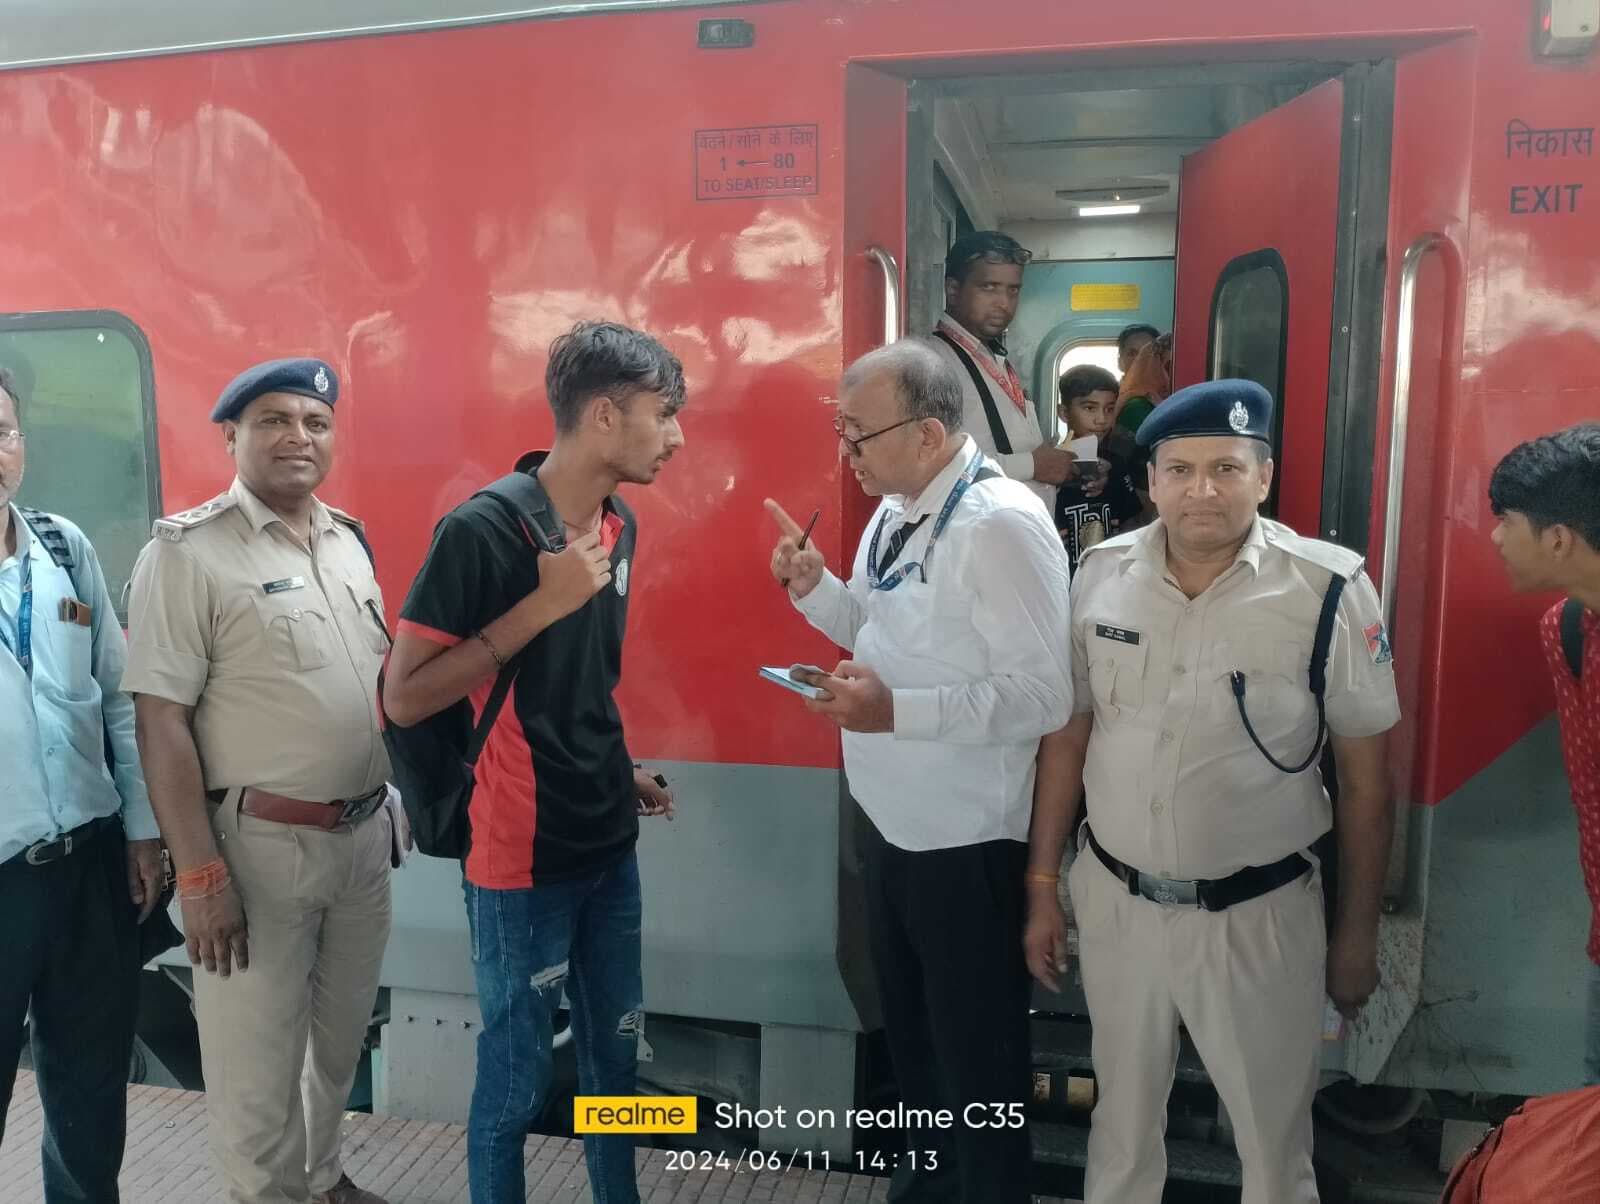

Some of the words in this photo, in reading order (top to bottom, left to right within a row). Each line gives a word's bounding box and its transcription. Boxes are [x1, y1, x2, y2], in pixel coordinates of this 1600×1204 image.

[1504, 117, 1595, 159] निकास
[719, 156, 727, 171] 1
[773, 152, 796, 169] 80
[704, 179, 721, 193] TO
[725, 175, 813, 192] SEAT/SLEEP
[1510, 183, 1584, 214] EXIT
